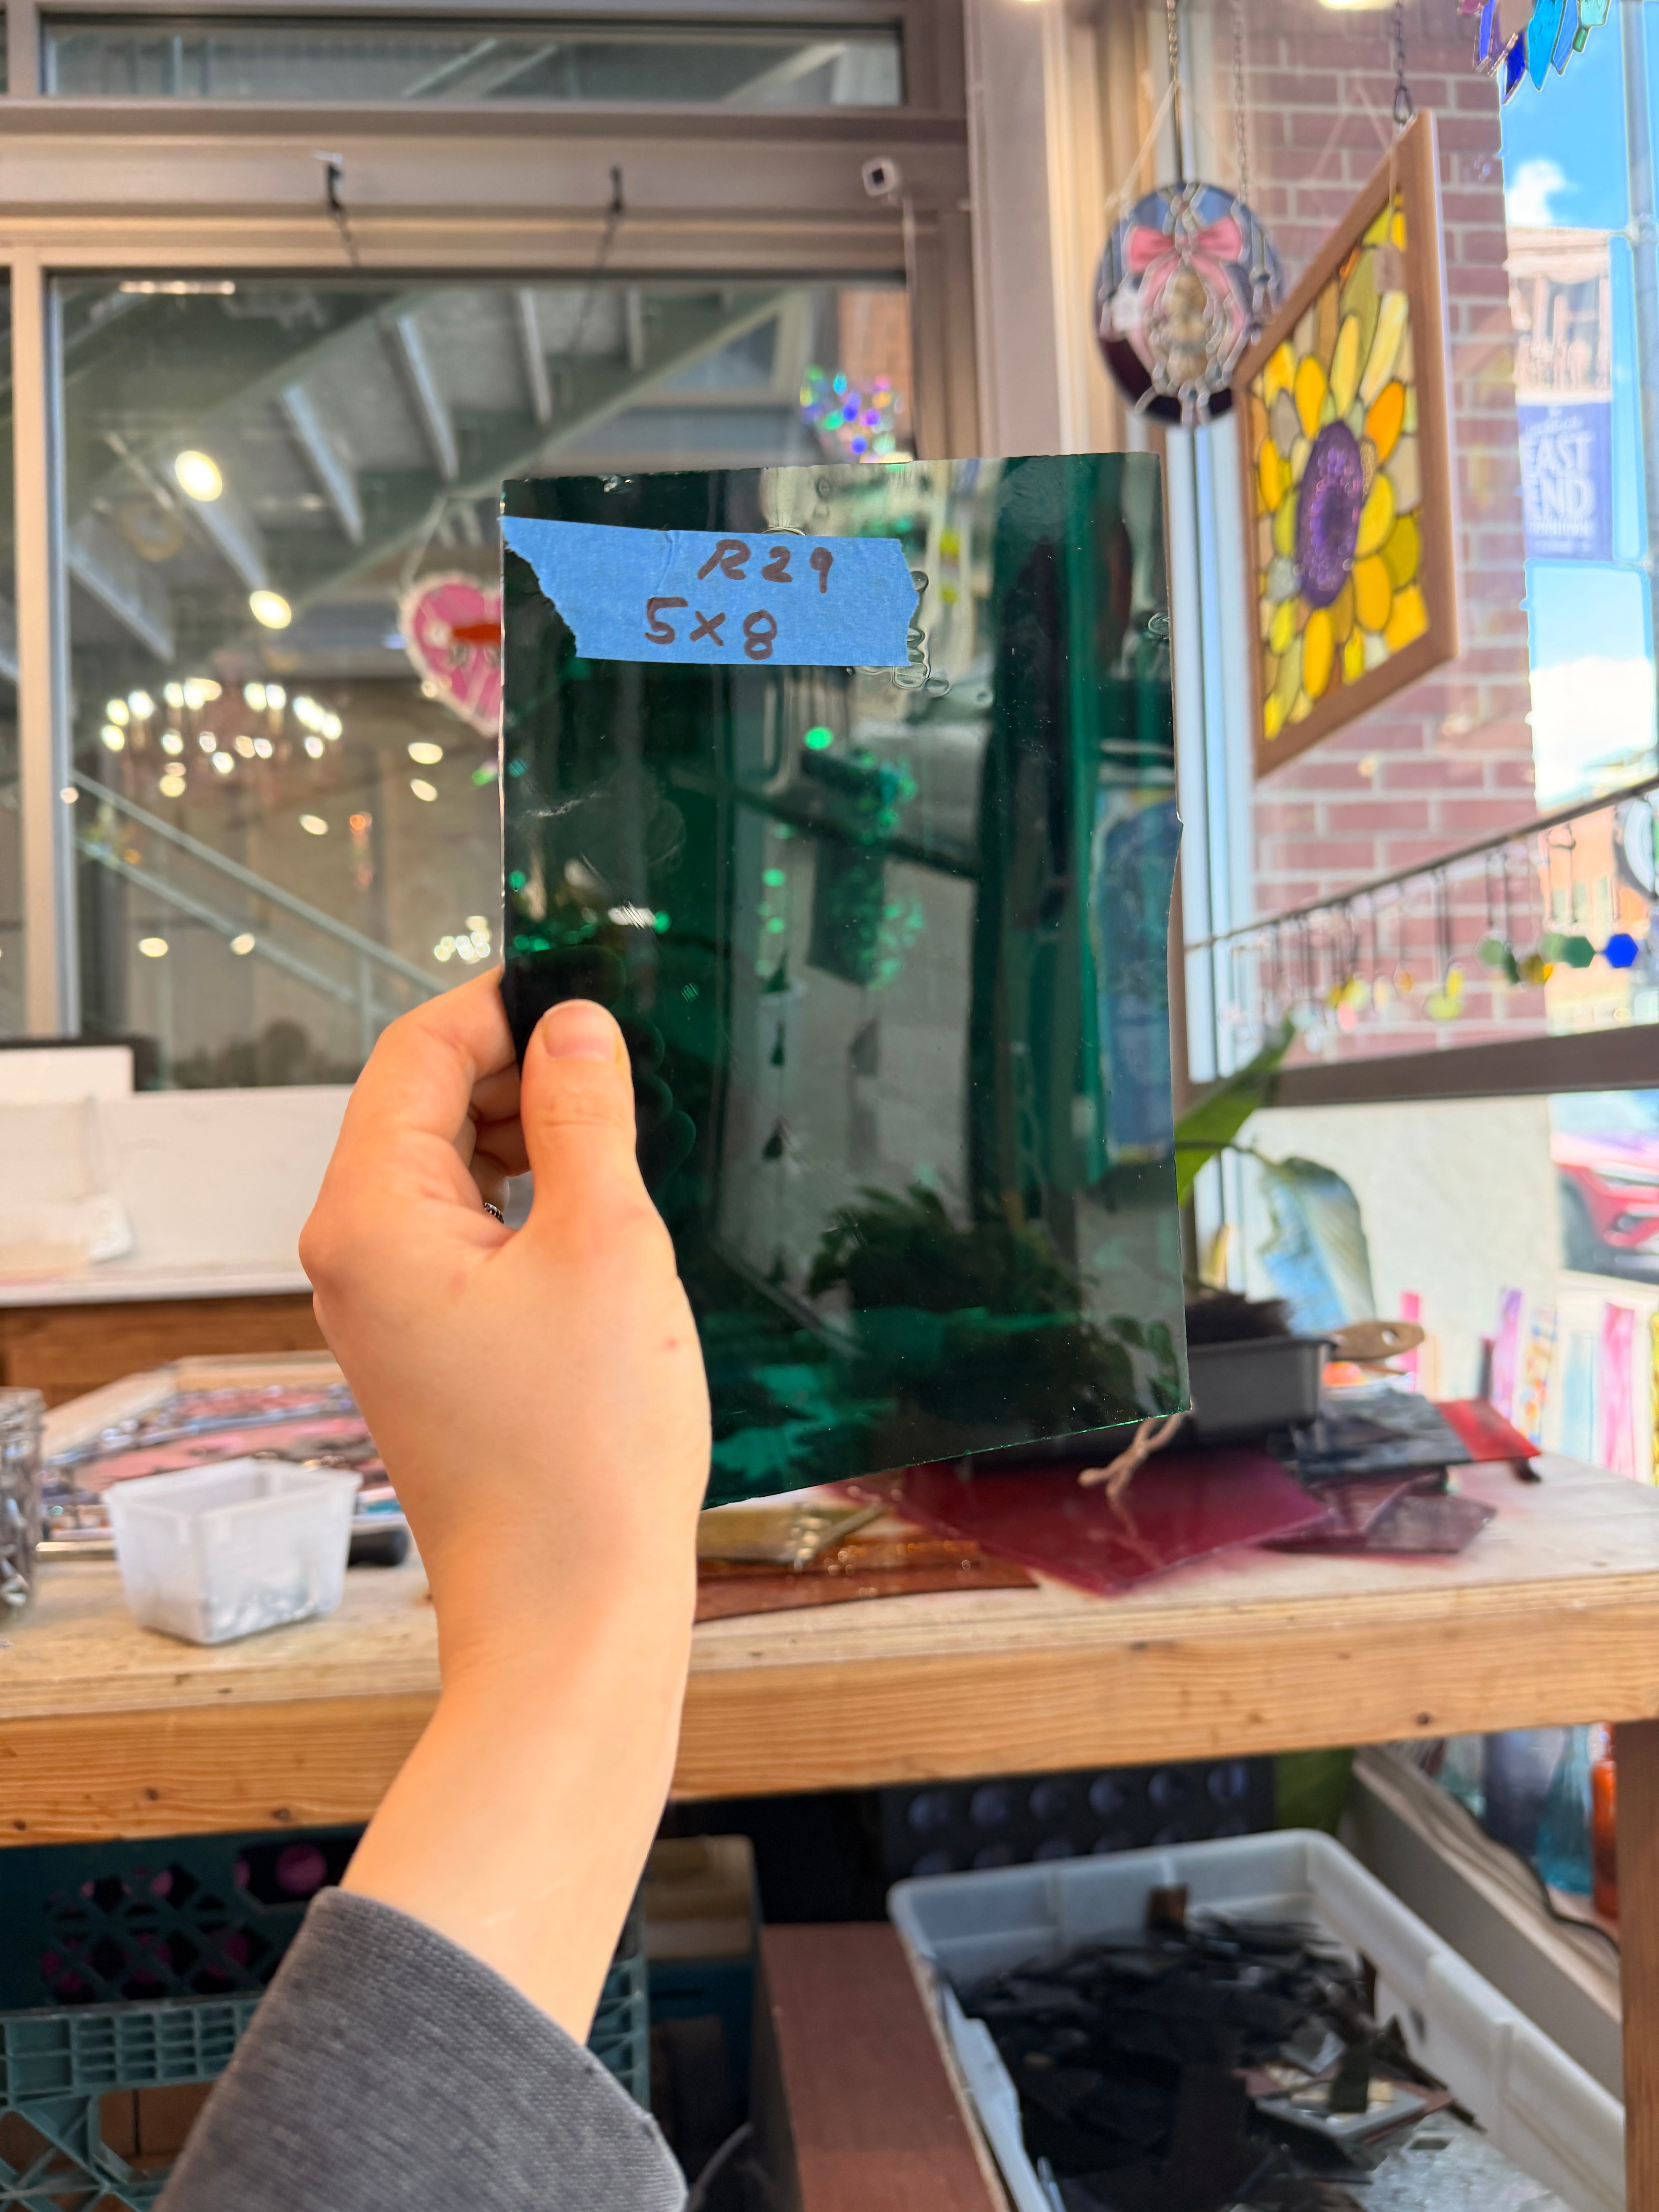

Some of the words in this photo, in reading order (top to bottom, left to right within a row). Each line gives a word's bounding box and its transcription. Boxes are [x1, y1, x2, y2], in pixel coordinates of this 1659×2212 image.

[1520, 431, 1594, 472] EAST
[1524, 475, 1594, 517] END
[696, 538, 834, 594] R29
